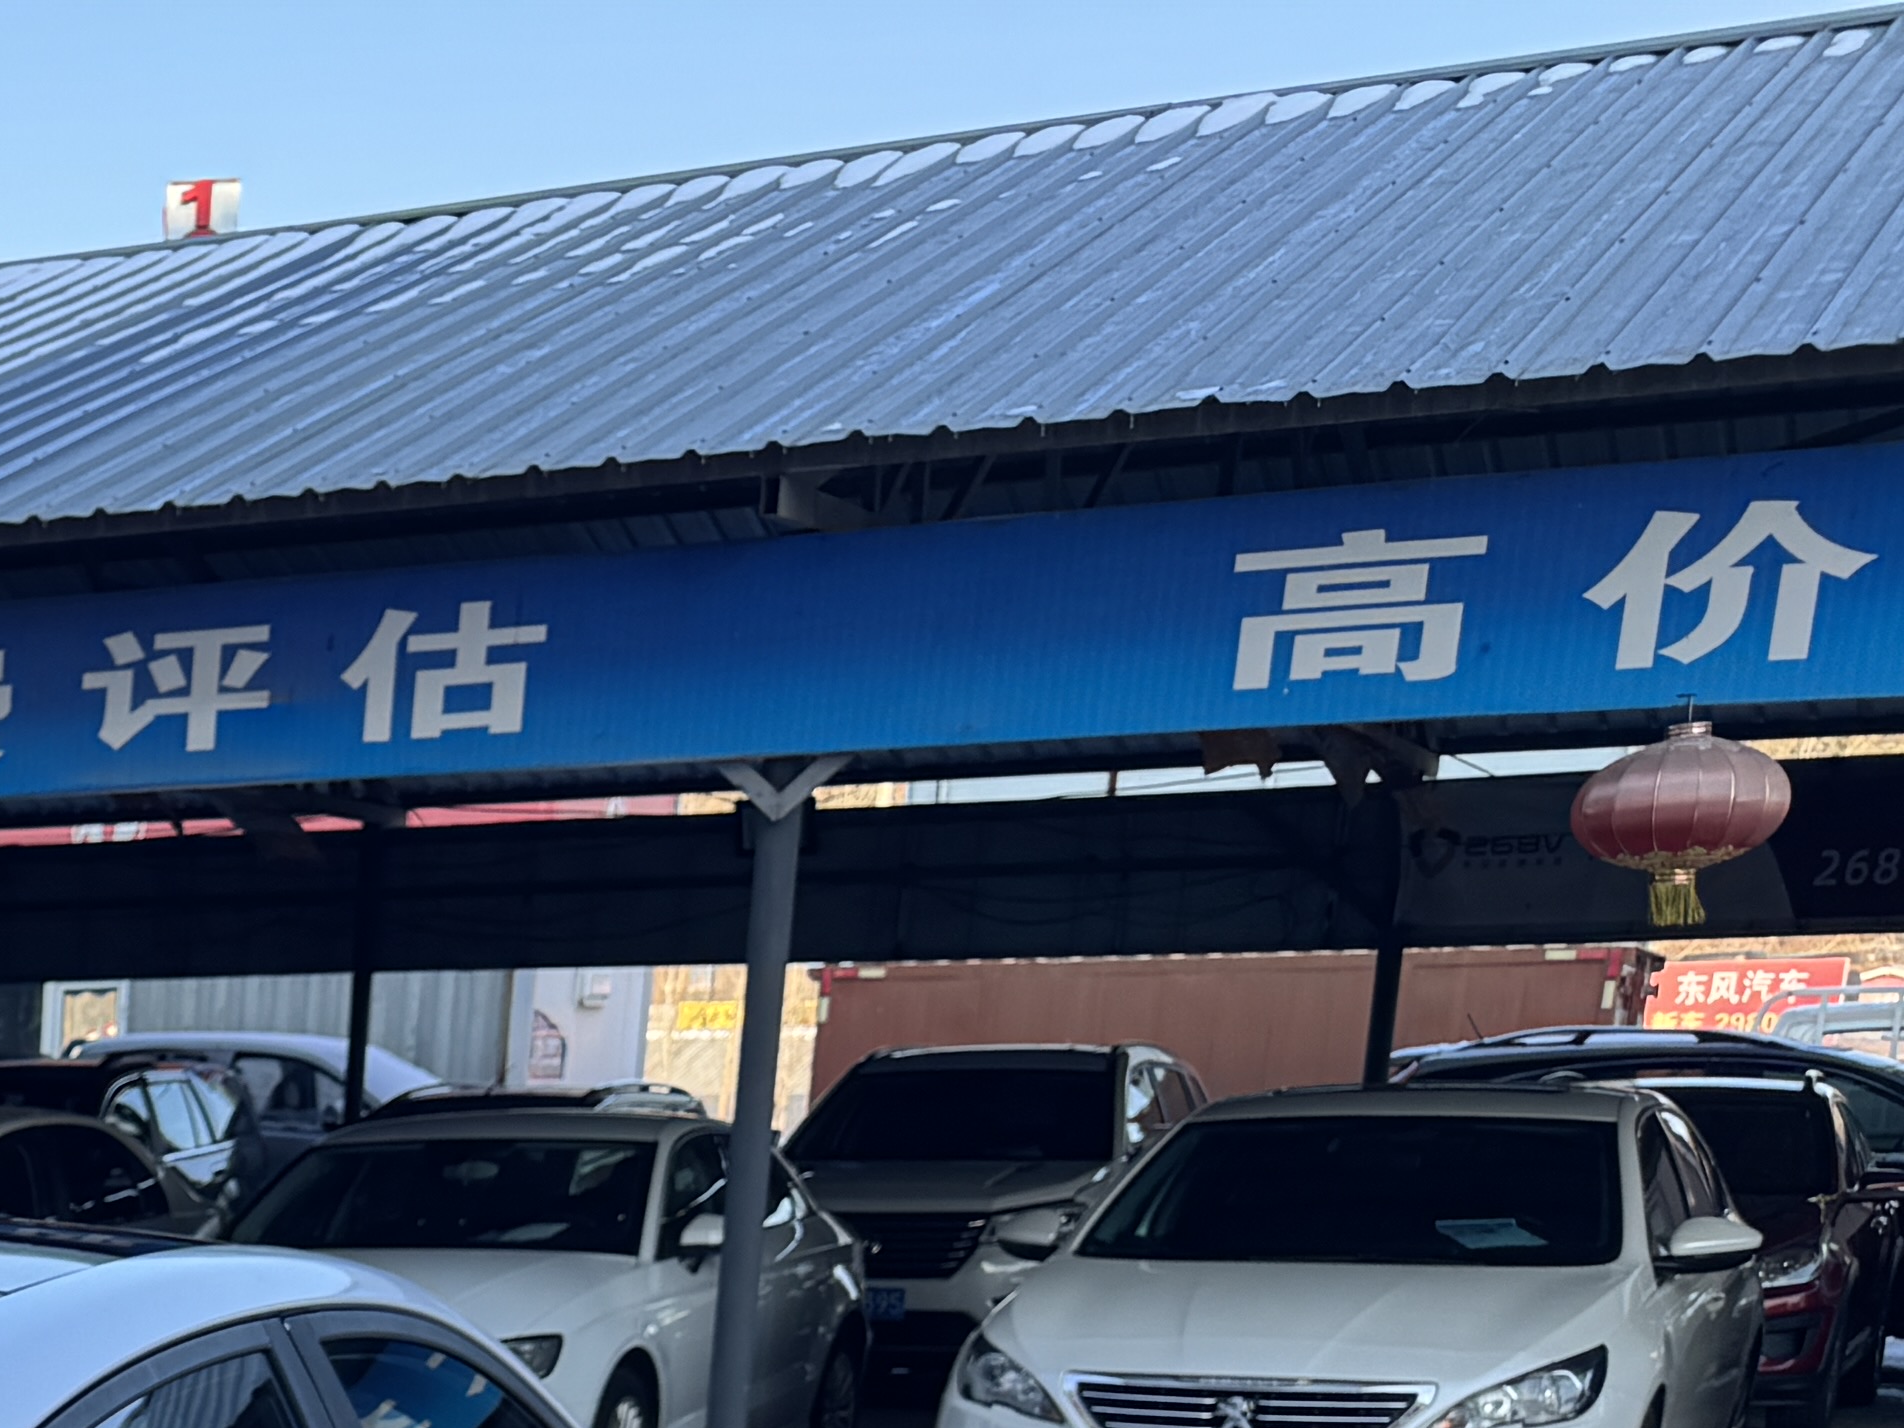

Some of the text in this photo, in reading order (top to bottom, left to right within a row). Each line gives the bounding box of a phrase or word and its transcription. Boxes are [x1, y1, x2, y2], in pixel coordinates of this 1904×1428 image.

[180, 179, 217, 237] 1
[1232, 500, 1878, 690] 高价
[1674, 968, 1810, 1006] 东风汽车
